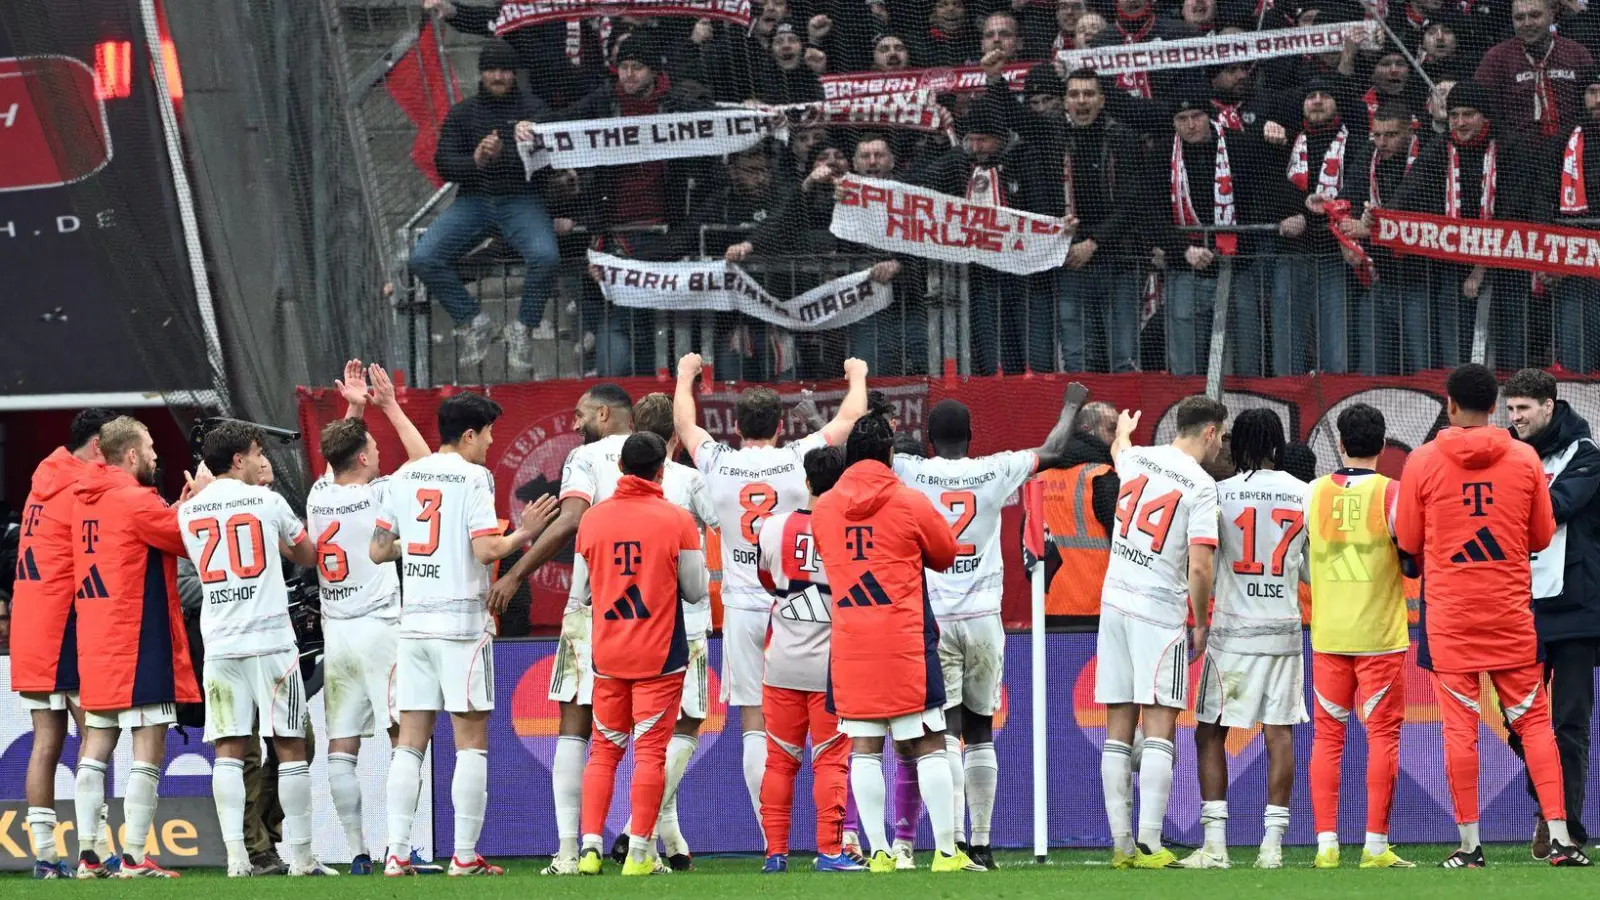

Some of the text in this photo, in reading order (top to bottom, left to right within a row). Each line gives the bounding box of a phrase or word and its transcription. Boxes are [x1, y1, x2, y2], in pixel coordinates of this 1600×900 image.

[597, 265, 678, 291] TARK
[730, 467, 760, 478] BAYERN
[915, 474, 926, 484] FC
[929, 476, 960, 487] BAYERN
[192, 502, 222, 513] BAYERN
[1225, 491, 1303, 504] FC BAYERN MÜNCH
[408, 488, 443, 556] 3
[738, 482, 778, 546] 8
[941, 491, 976, 556] 2
[1116, 473, 1183, 555] 44
[188, 512, 267, 584] 20
[317, 520, 349, 583] 6
[1233, 507, 1304, 577] 17
[733, 549, 757, 565] GOR
[404, 562, 441, 579] INJAE
[210, 585, 257, 605] BISCHOF
[1247, 583, 1284, 598] OLISE
